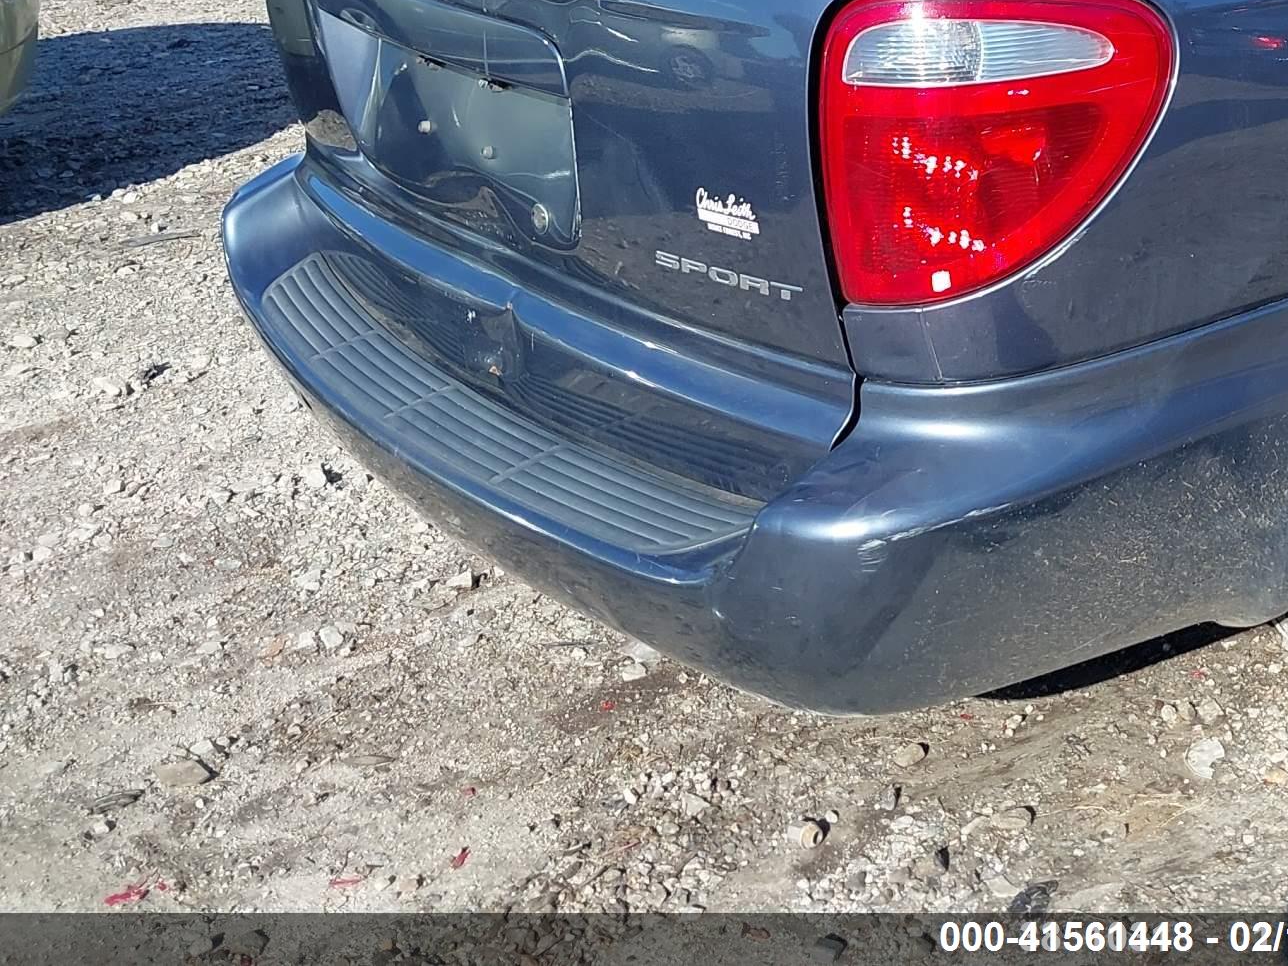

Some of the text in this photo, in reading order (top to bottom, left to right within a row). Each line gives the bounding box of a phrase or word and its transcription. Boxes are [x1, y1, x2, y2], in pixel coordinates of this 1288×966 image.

[696, 187, 725, 214] Chris
[727, 216, 754, 233] DODGE
[656, 250, 803, 301] SPORT
